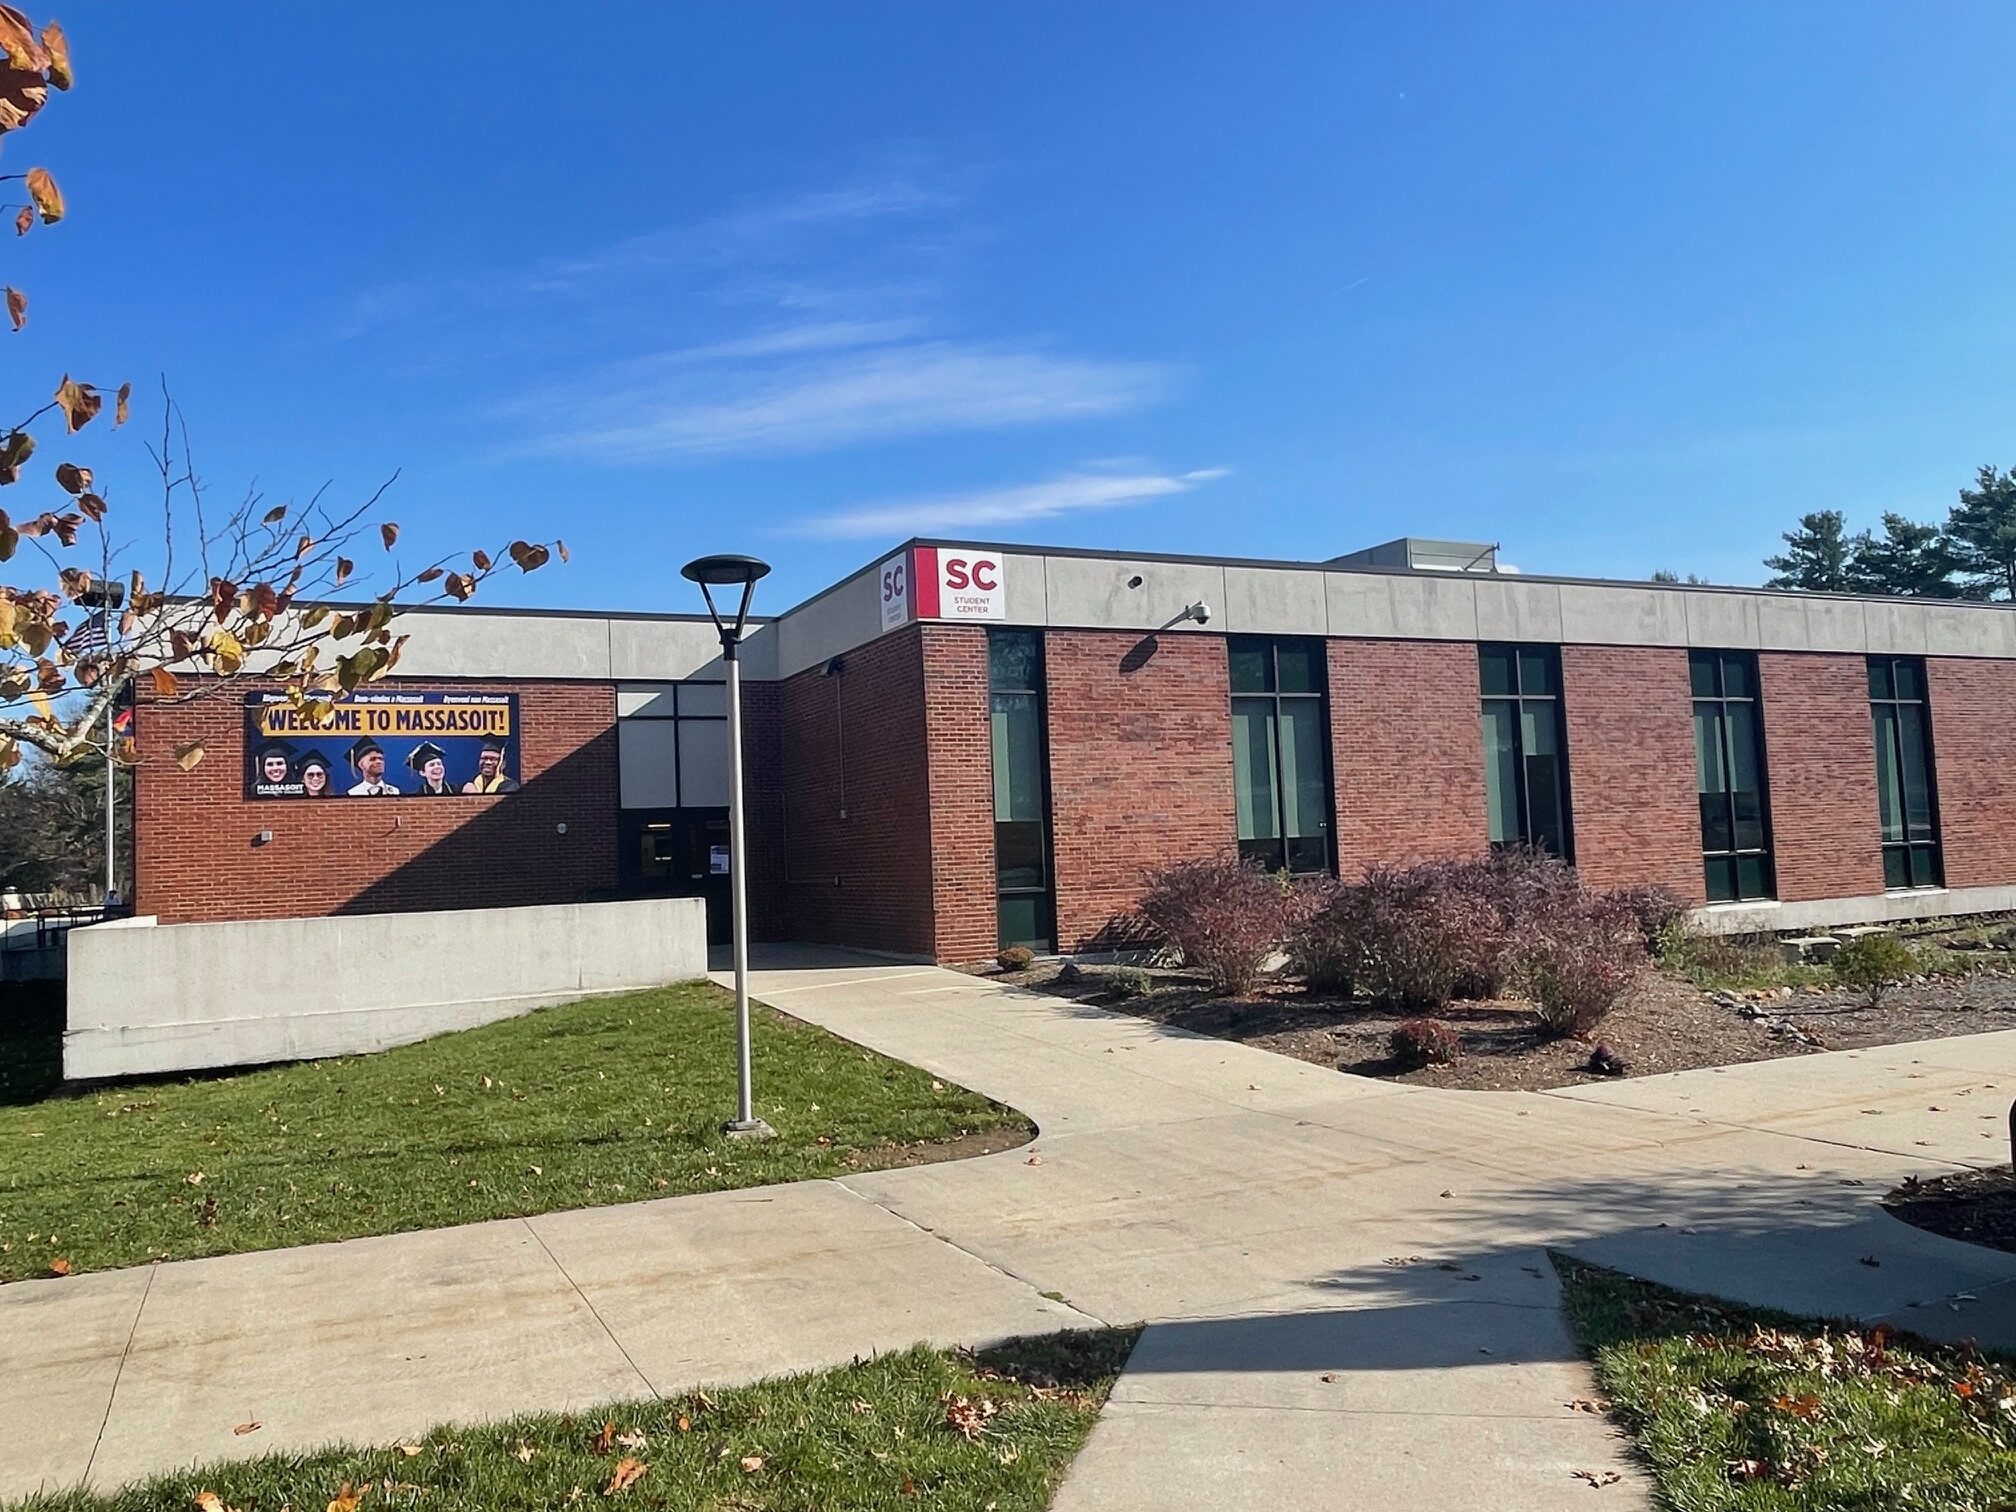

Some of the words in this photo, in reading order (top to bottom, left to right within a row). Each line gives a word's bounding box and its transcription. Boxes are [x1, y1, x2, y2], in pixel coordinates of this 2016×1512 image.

[883, 565, 904, 602] SC
[946, 559, 998, 591] SC
[954, 596, 990, 605] STUDENT
[956, 605, 989, 614] CENTER
[366, 709, 391, 731] TO
[396, 709, 505, 731] MASSASOIT!
